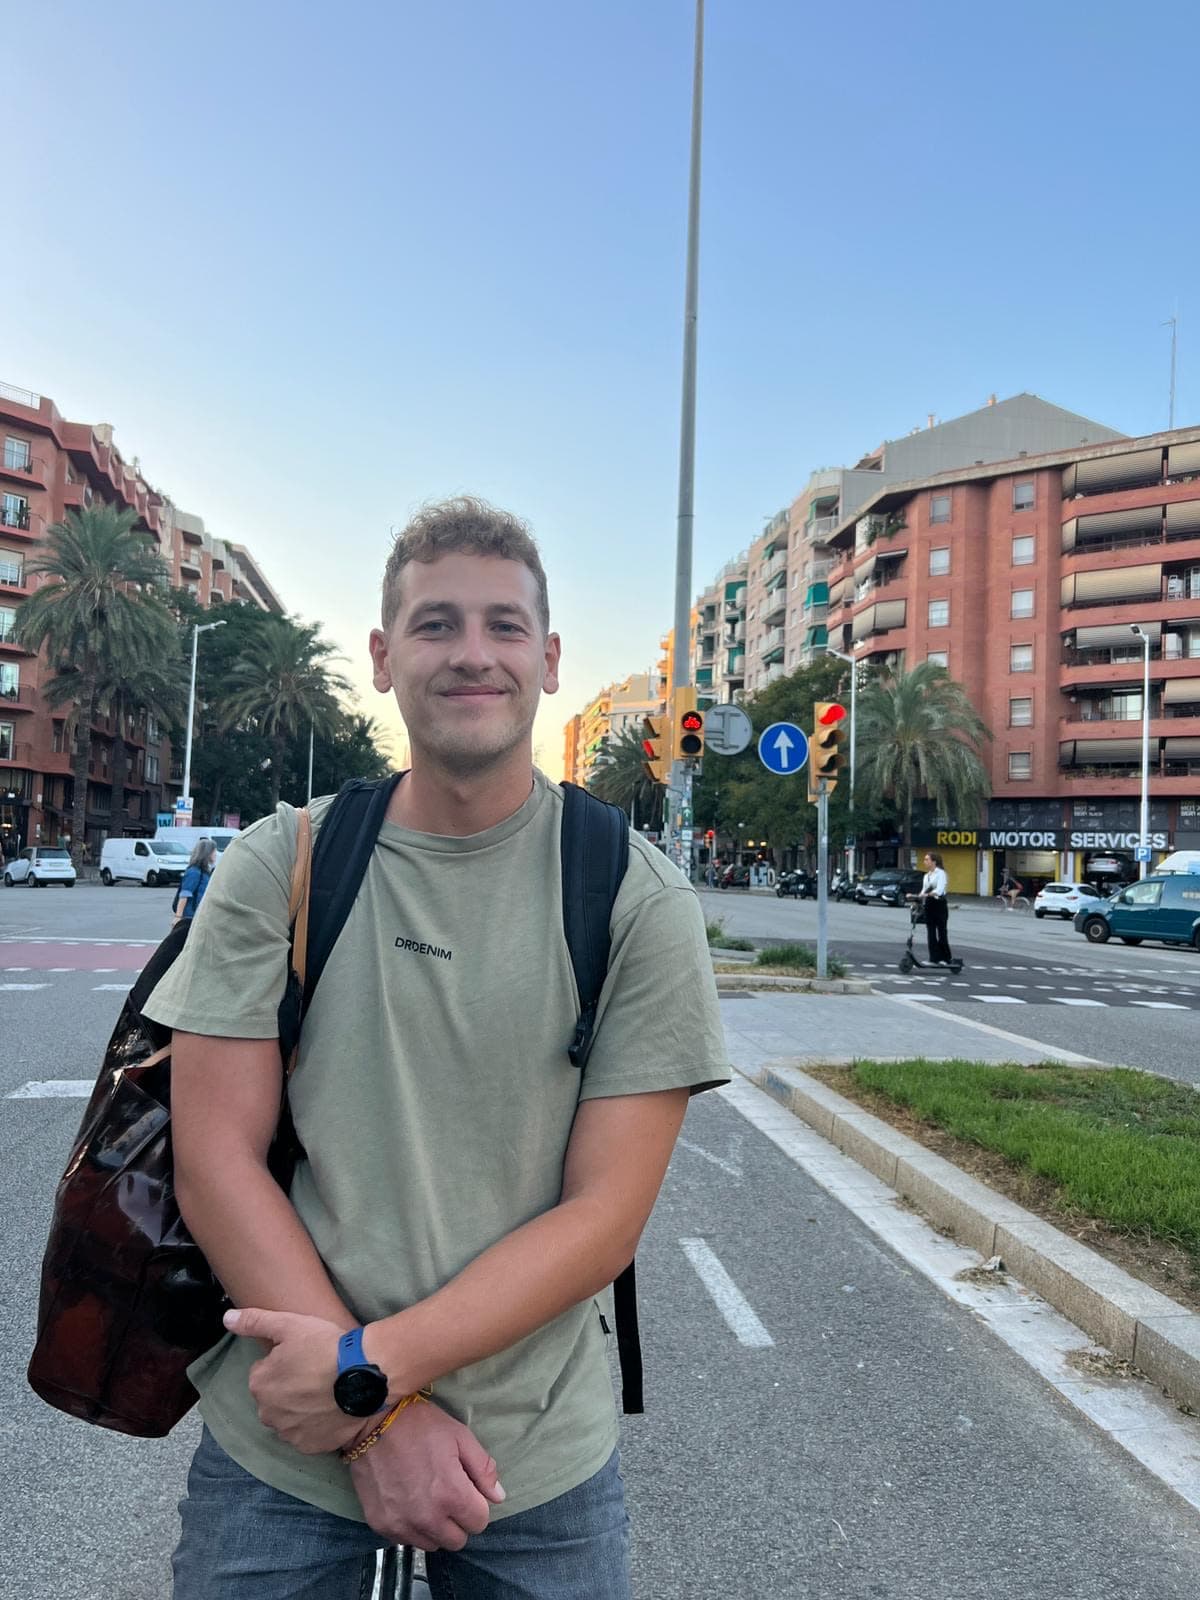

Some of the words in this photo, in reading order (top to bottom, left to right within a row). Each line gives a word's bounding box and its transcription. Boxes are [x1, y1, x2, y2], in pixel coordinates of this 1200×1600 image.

[937, 831, 977, 845] RODI
[990, 831, 1056, 847] MOTOR
[1138, 848, 1147, 859] P
[394, 937, 452, 960] DRDENIM
